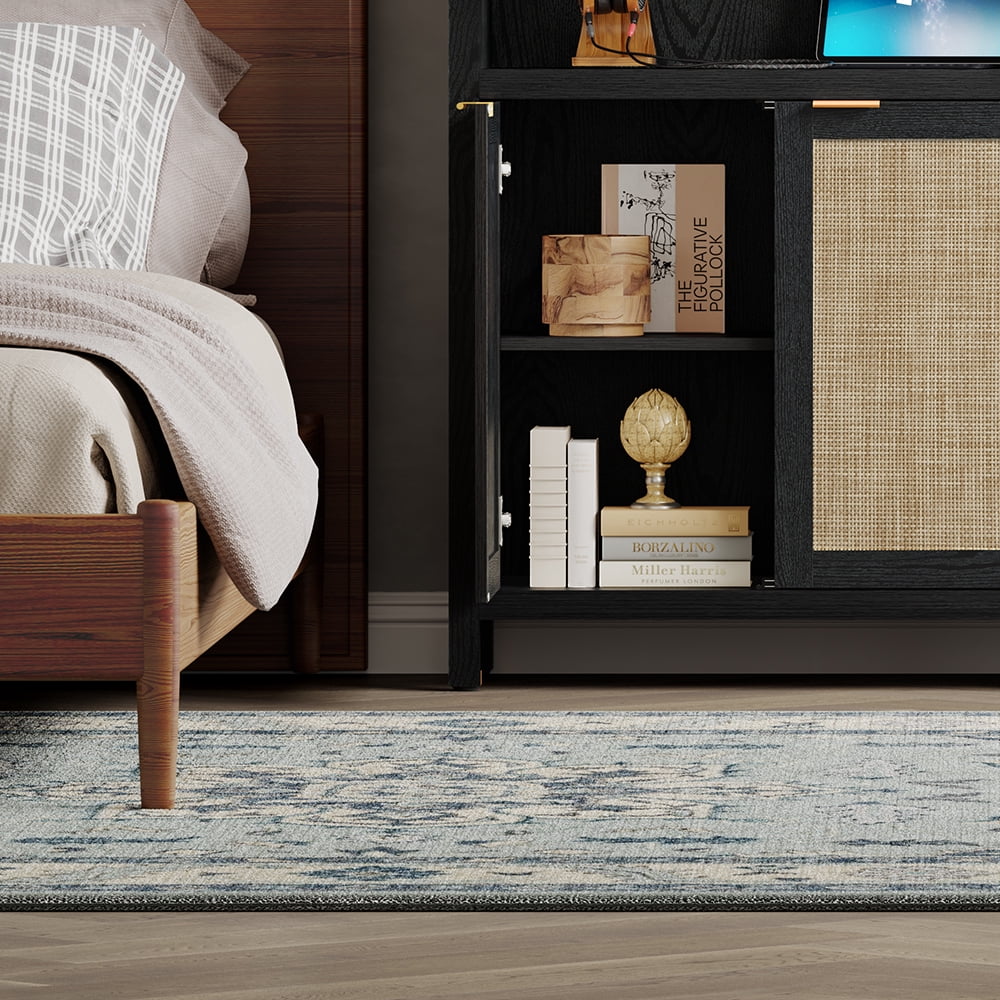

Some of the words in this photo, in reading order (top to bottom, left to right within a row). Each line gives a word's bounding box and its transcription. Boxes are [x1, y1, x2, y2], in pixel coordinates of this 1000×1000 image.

[693, 217, 708, 312] FIGURATIVE
[709, 234, 723, 312] POLLOCK
[678, 280, 692, 313] THE
[632, 542, 715, 553] BORZALINO
[632, 565, 677, 576] Miller
[680, 565, 727, 576] Harris
